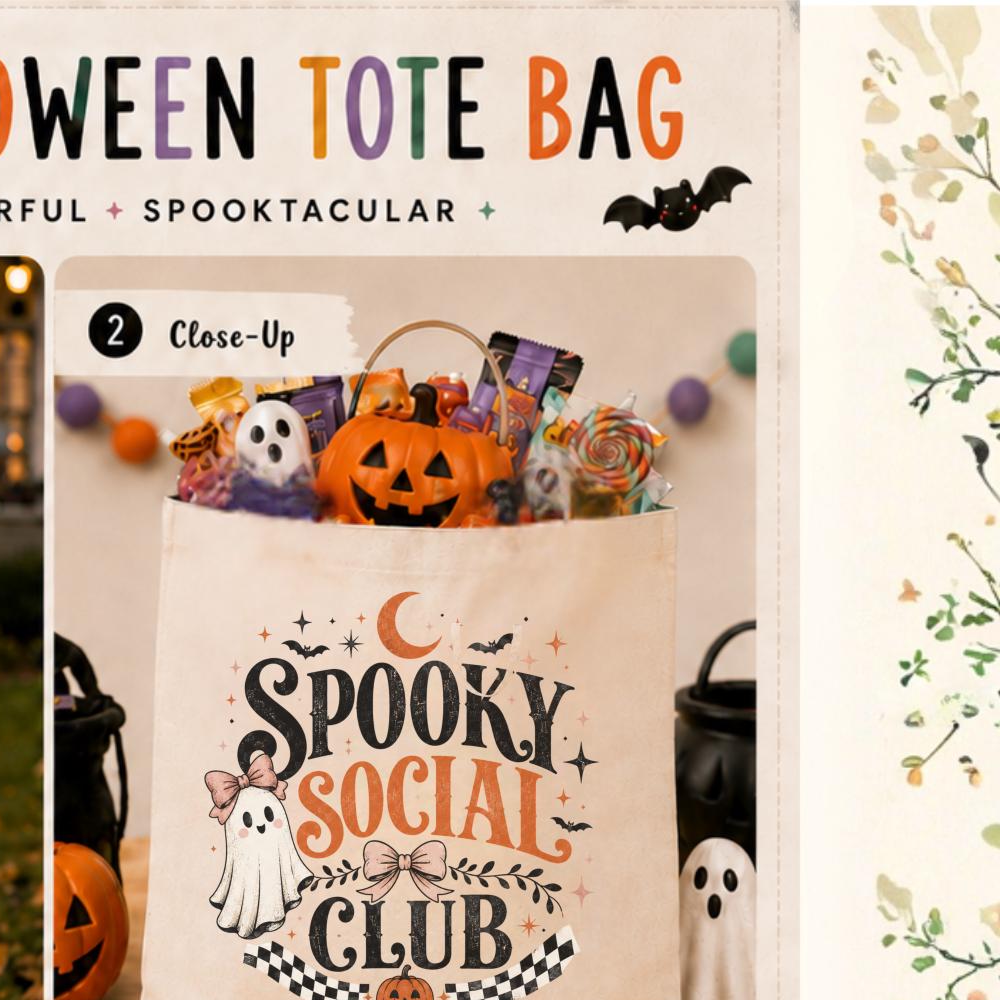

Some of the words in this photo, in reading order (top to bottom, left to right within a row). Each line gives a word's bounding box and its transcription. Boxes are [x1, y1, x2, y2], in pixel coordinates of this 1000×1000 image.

[237, 657, 576, 782] SPOOKY
[296, 755, 573, 864] SOCIAL
[308, 894, 514, 972] CLUB
